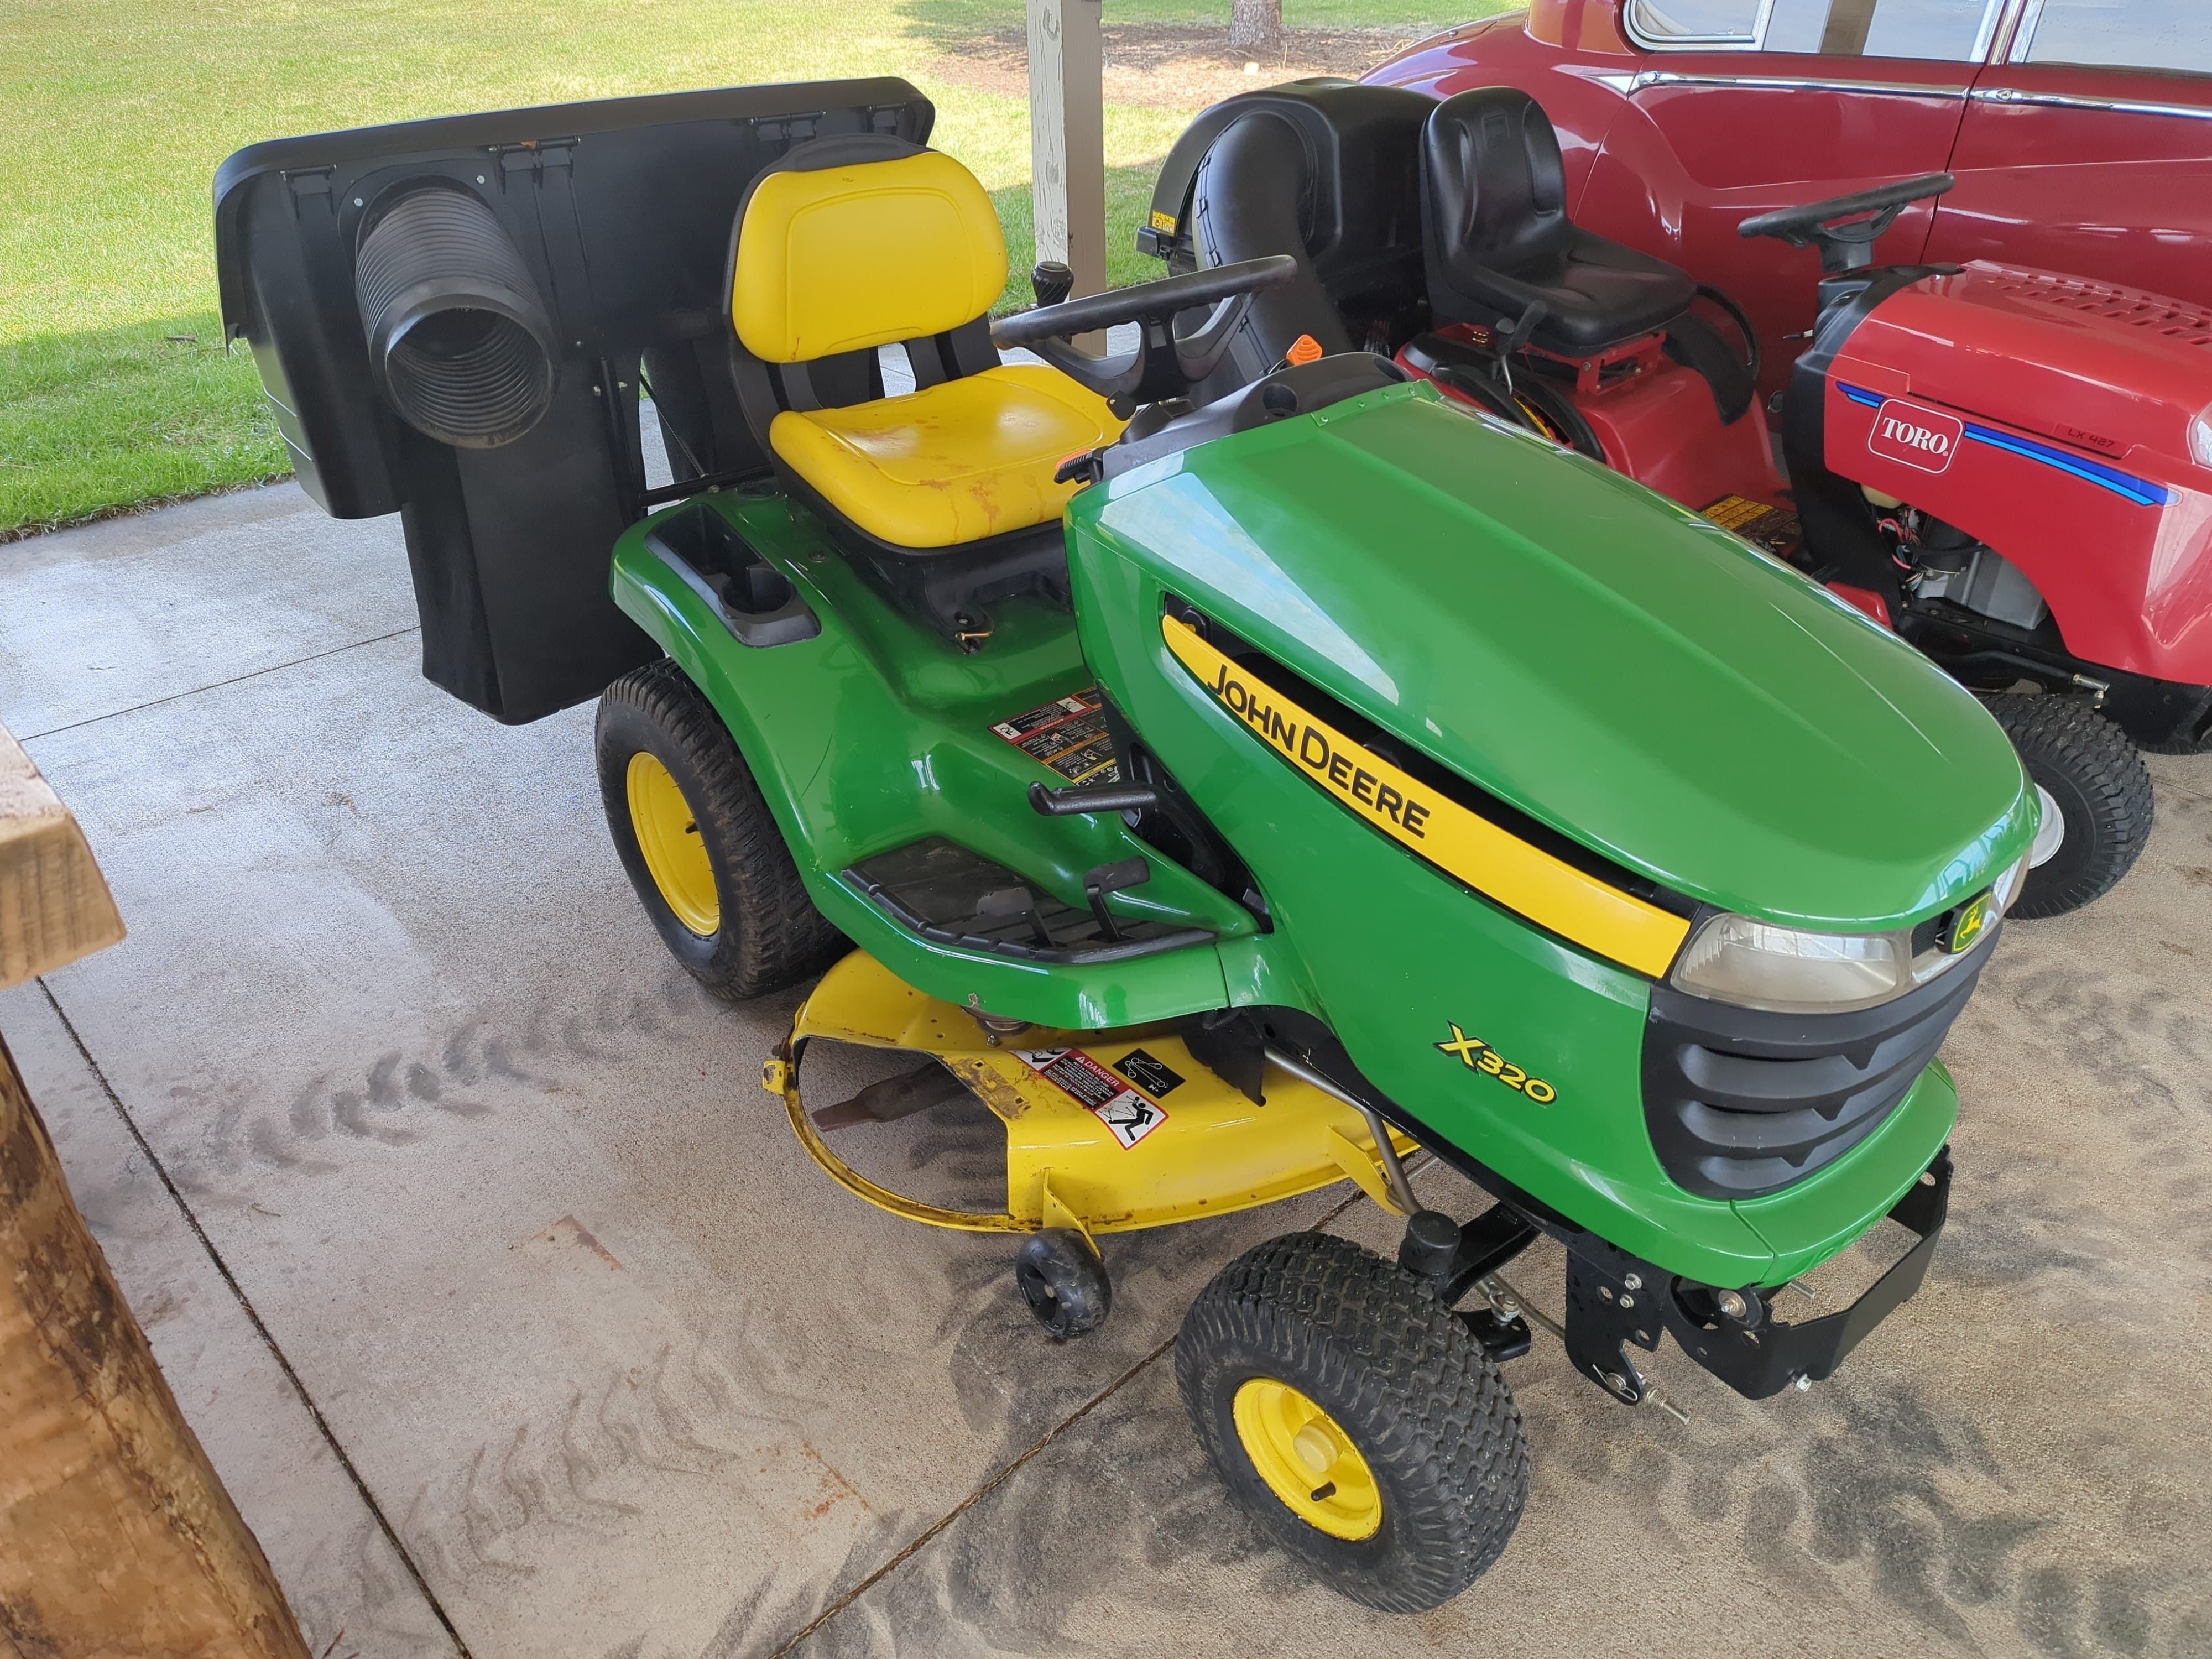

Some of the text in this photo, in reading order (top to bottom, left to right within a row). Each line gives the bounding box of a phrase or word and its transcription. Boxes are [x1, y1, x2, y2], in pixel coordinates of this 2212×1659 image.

[1881, 417, 1948, 454] TORO
[2068, 429, 2115, 447] LX 427
[1207, 664, 1431, 839] JOHN DEERE
[1084, 1061, 1120, 1087] DANGER
[1432, 1020, 1557, 1106] X320
